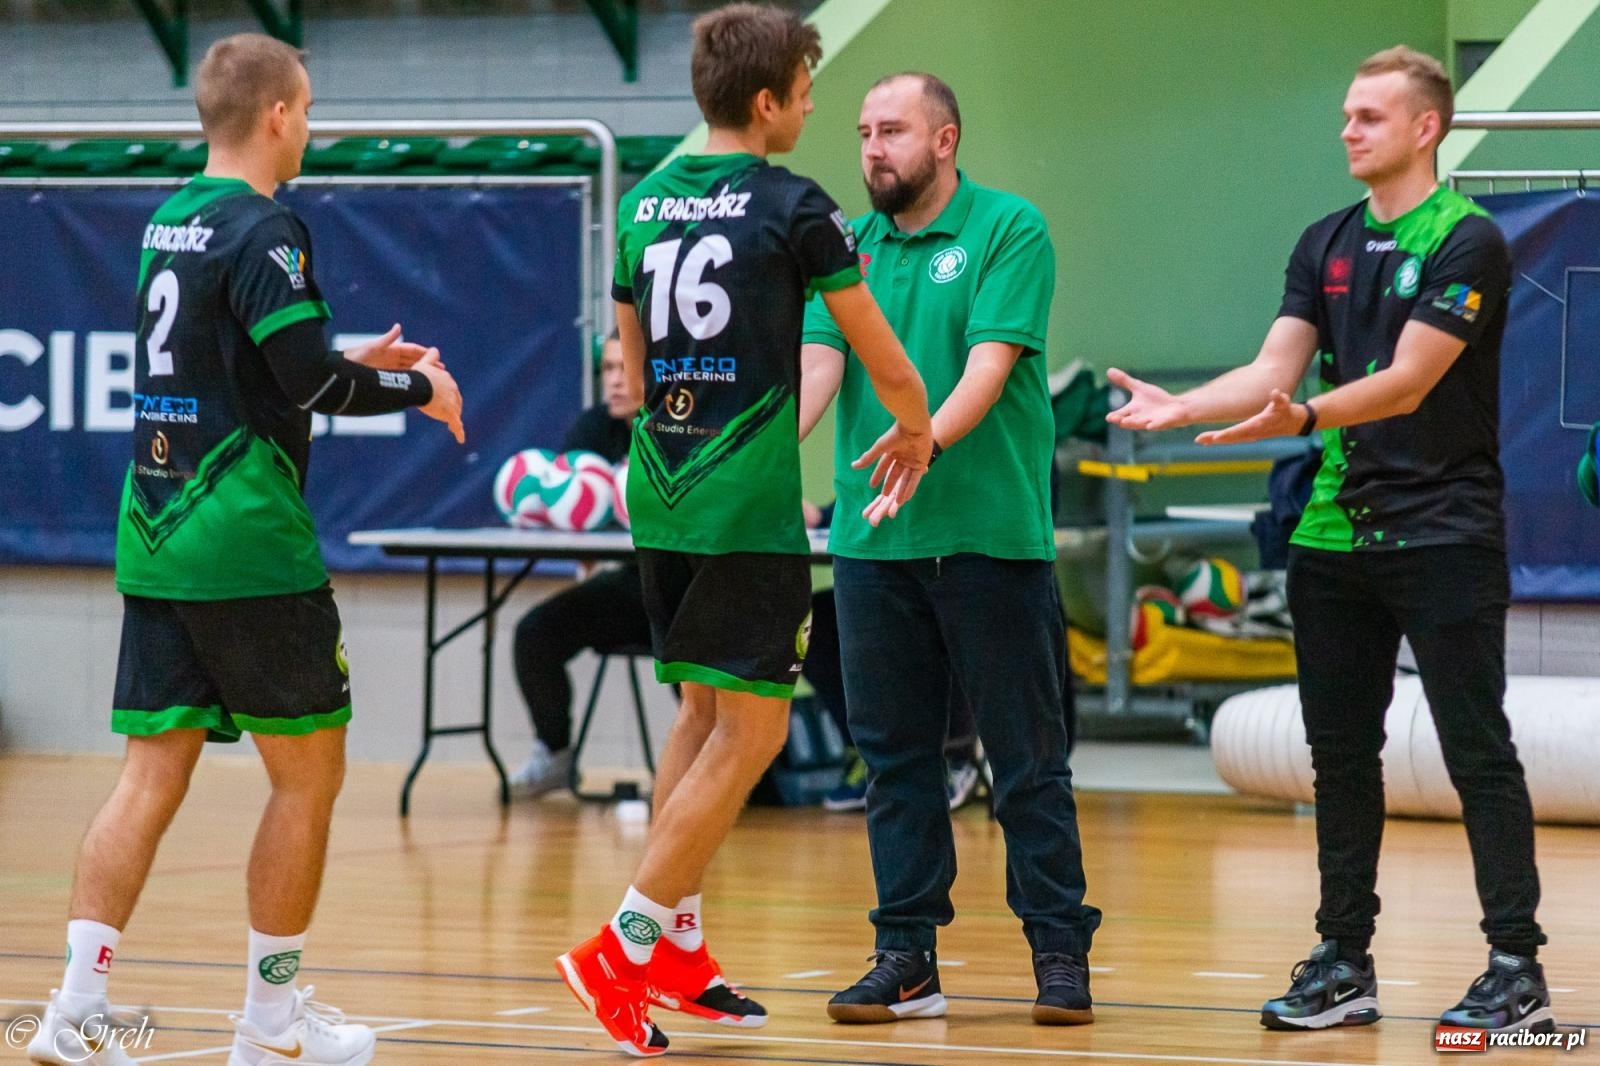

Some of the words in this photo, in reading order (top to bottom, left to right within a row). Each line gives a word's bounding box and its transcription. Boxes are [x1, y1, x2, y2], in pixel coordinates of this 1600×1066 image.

[642, 234, 734, 343] 16
[146, 269, 179, 378] 2
[656, 422, 685, 434] Studio
[675, 913, 696, 929] R
